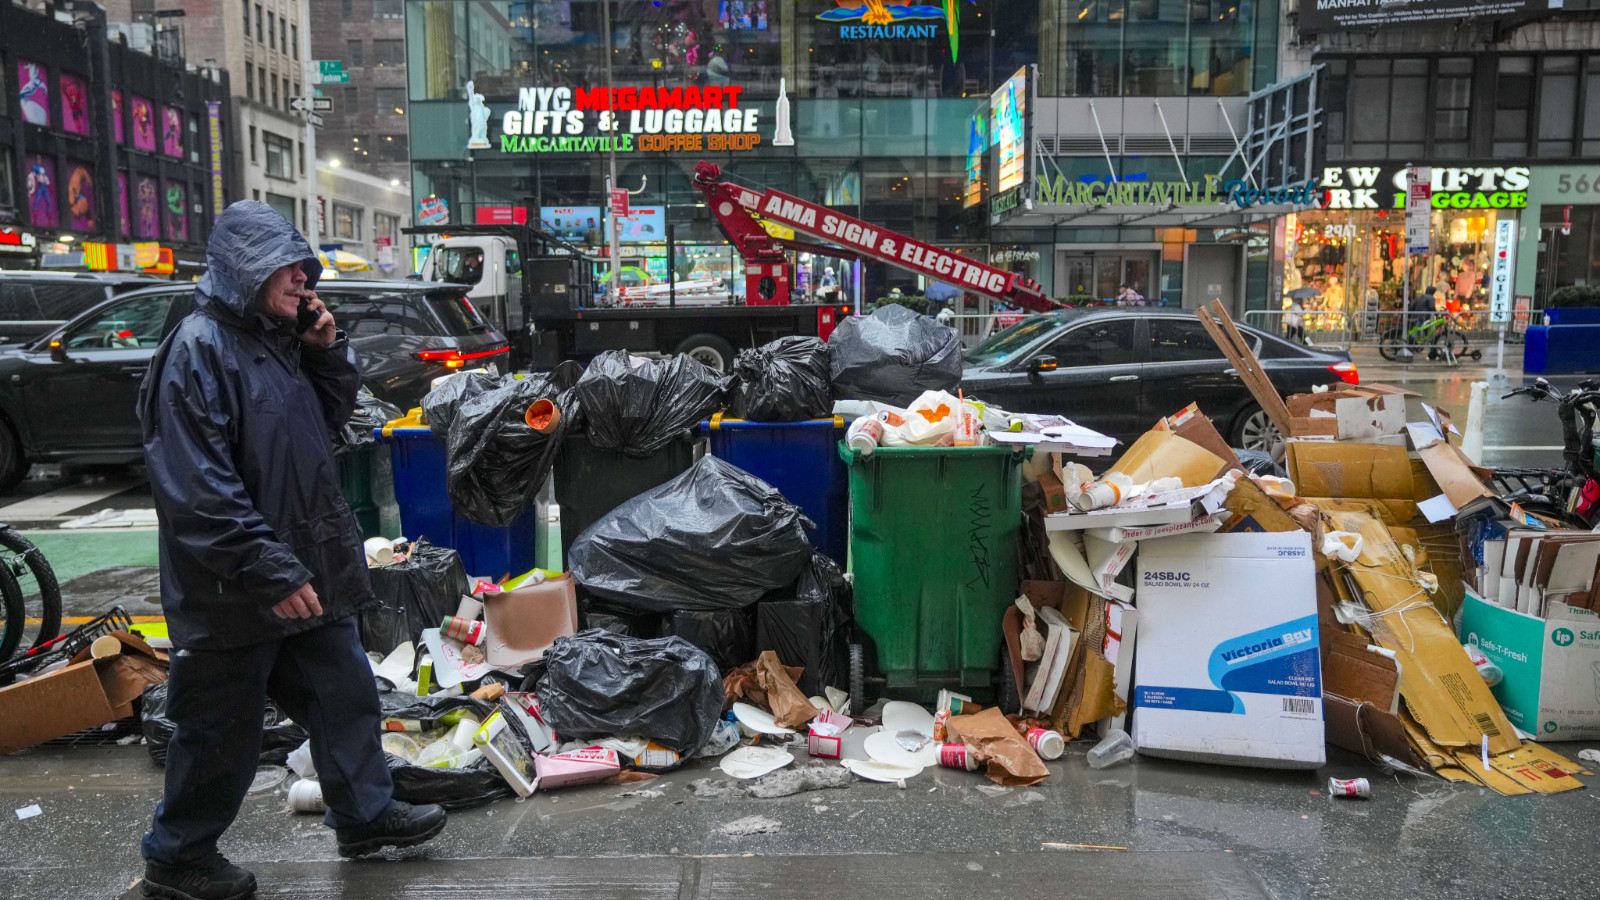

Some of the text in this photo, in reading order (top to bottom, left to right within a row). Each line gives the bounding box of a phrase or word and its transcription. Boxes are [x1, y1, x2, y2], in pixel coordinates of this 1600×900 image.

[840, 25, 938, 38] RESTAURANT
[518, 86, 743, 112] NYC MEGAMART
[502, 109, 759, 134] GIFTS & LUGGAGE
[210, 117, 220, 171] MIDTOWN
[500, 134, 761, 152] MARGARITAVILLE COFFEE SHOP
[1320, 167, 1381, 187] EW
[1037, 174, 1222, 206] MARGARITAVILLE
[1223, 179, 1316, 208] Resort
[1394, 192, 1528, 208] LGGAGE
[765, 195, 1006, 293] AMA SIGN & ELECTRIC
[1495, 274, 1506, 320] GIFTS
[1122, 529, 1143, 538] Order
[1154, 517, 1214, 536] joespizzanyc.com
[1144, 572, 1190, 580] 24SBJC
[1221, 637, 1284, 662] Victoria
[1282, 628, 1312, 644] Bay
[1556, 630, 1571, 644] ip
[1480, 638, 1528, 663] Safe-T-Fresh
